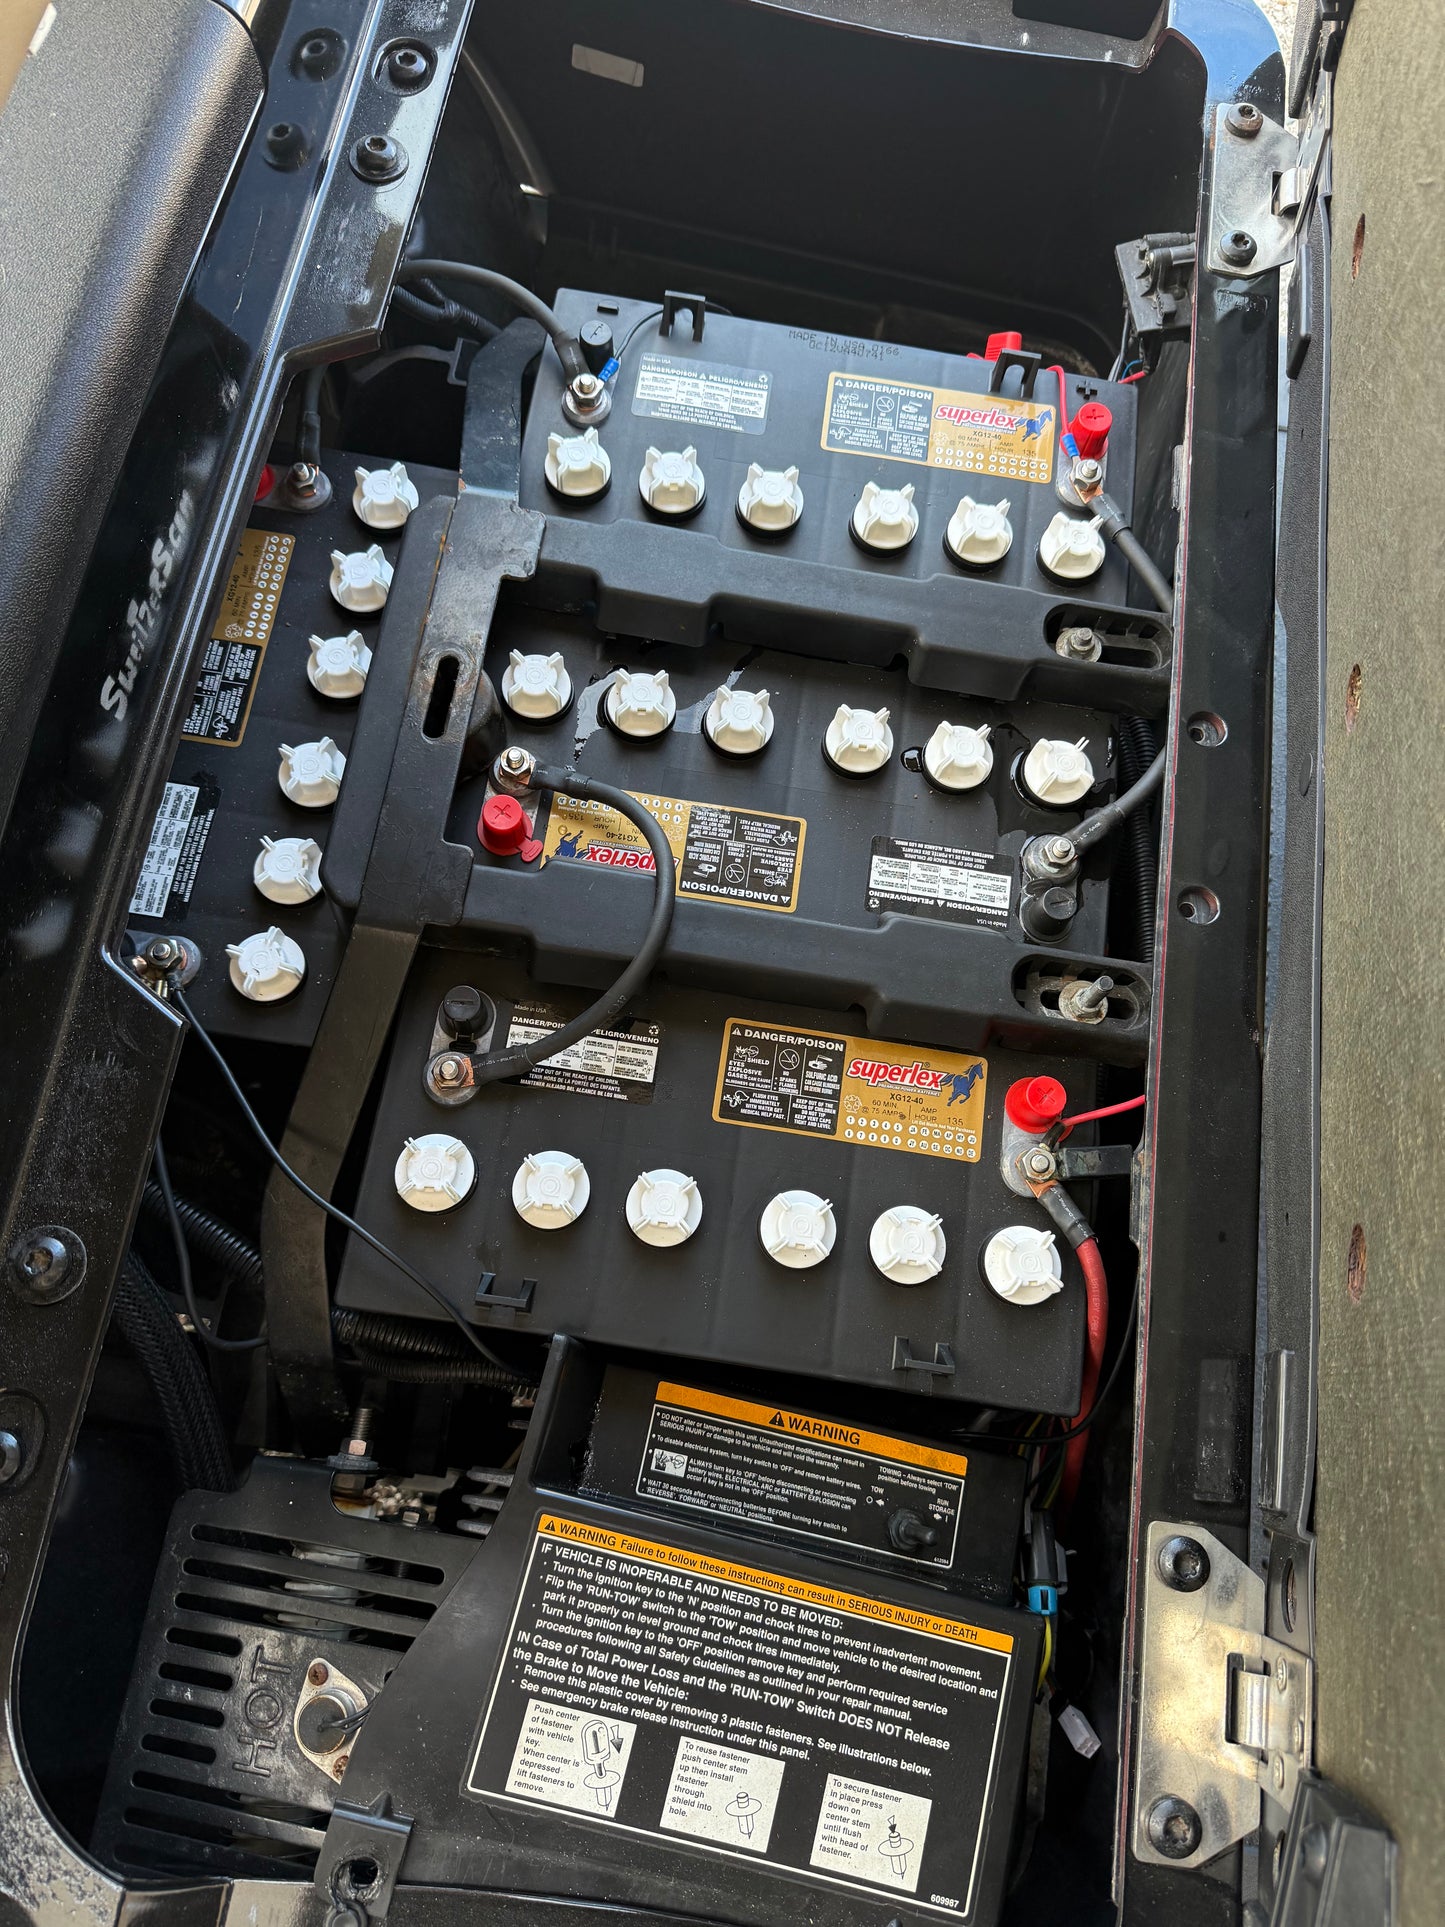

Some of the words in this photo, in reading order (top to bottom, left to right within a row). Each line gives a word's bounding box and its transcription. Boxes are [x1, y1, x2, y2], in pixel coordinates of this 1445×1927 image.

[789, 330, 816, 341] MADE
[845, 380, 931, 400] DANGER/POISON
[937, 406, 1018, 430] superlex
[1022, 448, 1036, 456] 135
[605, 831, 638, 842] XG12-40
[760, 858, 793, 868] EXPLOSIVE
[753, 867, 775, 876] SHIELD
[681, 880, 778, 902] DANGER/POISON
[868, 889, 934, 905] PELIGRO/VENENO
[946, 901, 1008, 916] DANGER/POISON
[744, 1028, 843, 1051] DANGER/POISON
[728, 1059, 744, 1067] EYES
[746, 1057, 769, 1065] SHIELD
[727, 1065, 762, 1075] EXPLOSIVE
[727, 1071, 747, 1079] GASES
[849, 1059, 946, 1089] superlex
[778, 1086, 798, 1094] SMOKING
[889, 1092, 923, 1104] XG12-40
[871, 1106, 880, 1114] 75
[914, 1113, 937, 1122] HOUR
[946, 1116, 963, 1125] 135
[788, 1415, 860, 1445] WARNING
[879, 1465, 901, 1477] TOWING
[906, 1473, 926, 1483] Always
[870, 1485, 884, 1494] TOW
[899, 1478, 917, 1488] before
[928, 1503, 954, 1515] STORAGE
[936, 1497, 949, 1506] RUN
[541, 1542, 553, 1553] IF
[555, 1545, 603, 1567] VEHICLE
[605, 1558, 617, 1570] IS
[618, 1562, 693, 1590] INOPERABLE
[693, 1582, 719, 1596] AND
[721, 1588, 760, 1607] NEEDS
[763, 1599, 778, 1612] TO
[780, 1603, 797, 1617] BE
[798, 1608, 843, 1629] MOVED:
[560, 1522, 616, 1546] WARNING
[620, 1538, 654, 1556] Failure
[655, 1548, 665, 1559] to
[668, 1551, 697, 1567] follow
[699, 1559, 726, 1575] these
[727, 1566, 785, 1593] instructions
[787, 1584, 805, 1596] can
[806, 1590, 834, 1603] result
[836, 1595, 845, 1606] in
[847, 1598, 892, 1618] SERIOUS
[894, 1610, 931, 1628] INJURY
[932, 1622, 943, 1631] or
[944, 1623, 978, 1640] DEATH
[553, 1560, 574, 1575] Turn
[576, 1567, 593, 1580] the
[634, 1581, 653, 1597] key
[655, 1587, 665, 1598] to
[667, 1590, 684, 1603] the
[700, 1600, 741, 1618] position
[743, 1611, 763, 1623] and
[764, 1616, 795, 1632] chock
[796, 1623, 819, 1638] tires
[821, 1630, 831, 1641] to
[832, 1634, 871, 1651] prevent
[929, 1660, 982, 1680] movement.
[545, 1573, 564, 1589] Flip
[566, 1579, 583, 1592] the
[641, 1600, 675, 1615] switch
[677, 1607, 687, 1618] to
[689, 1610, 706, 1623] the
[738, 1625, 780, 1642] position
[781, 1636, 801, 1647] and
[802, 1641, 830, 1655] move
[832, 1649, 867, 1665] vehicle
[869, 1657, 879, 1668] to
[881, 1660, 898, 1672] the
[899, 1665, 936, 1682] desired
[937, 1674, 977, 1693] location
[978, 1687, 998, 1699] and
[512, 1646, 532, 1661] the
[533, 1651, 569, 1670] Brake
[571, 1661, 583, 1674] to
[586, 1664, 618, 1683] Move
[620, 1673, 640, 1688] the
[643, 1678, 689, 1700] Vehicle:
[516, 1630, 531, 1643] IN
[532, 1634, 562, 1652] Case
[564, 1643, 578, 1655] of
[580, 1645, 609, 1663] Total
[610, 1653, 649, 1673] Power
[650, 1663, 680, 1681] Loss
[682, 1674, 705, 1687] and
[707, 1678, 727, 1692] the
[796, 1700, 835, 1720] Switch
[838, 1710, 873, 1730] DOES
[875, 1720, 902, 1737] NOT
[904, 1727, 950, 1750] Release
[232, 1645, 292, 1778] HOT
[533, 1703, 554, 1715] Push
[555, 1710, 580, 1721] center
[530, 1715, 540, 1723] of
[540, 1716, 573, 1731] fastener
[525, 1735, 541, 1747] key.
[528, 1726, 544, 1736] with
[546, 1731, 574, 1743] vehicle
[930, 1893, 959, 1908] 609987
